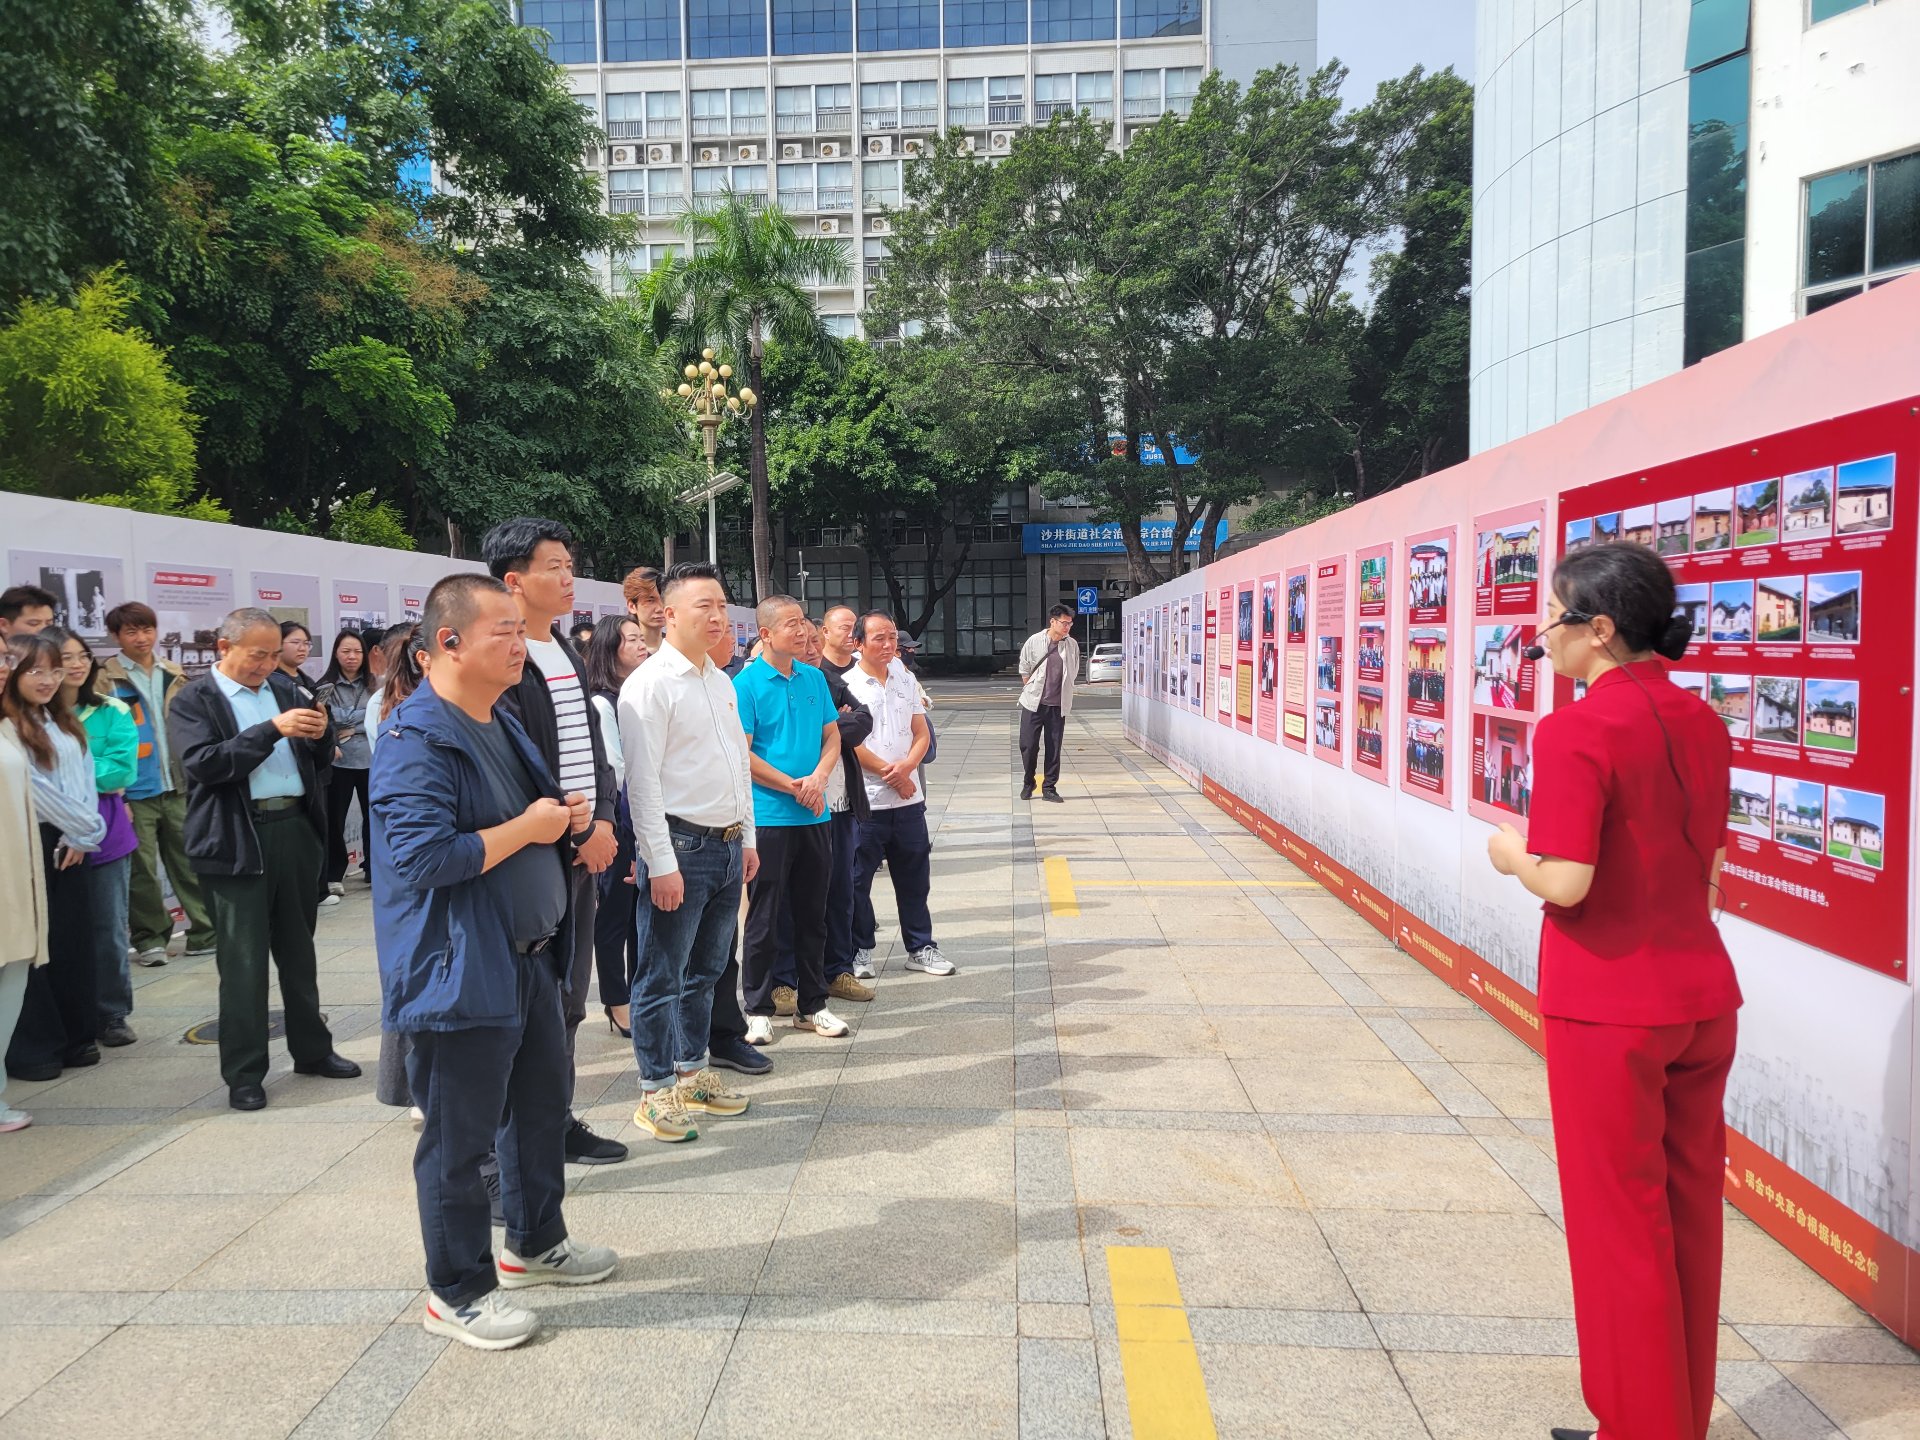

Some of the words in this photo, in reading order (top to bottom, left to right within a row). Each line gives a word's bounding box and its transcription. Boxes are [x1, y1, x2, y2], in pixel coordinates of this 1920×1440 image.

[1040, 527, 1202, 541] 沙井街道社会治综合治中
[1720, 861, 1829, 907] 革命旧址并建立革命传统教育基地。
[1745, 1169, 1879, 1283] 瑞金中央革命根据地纪念馆
